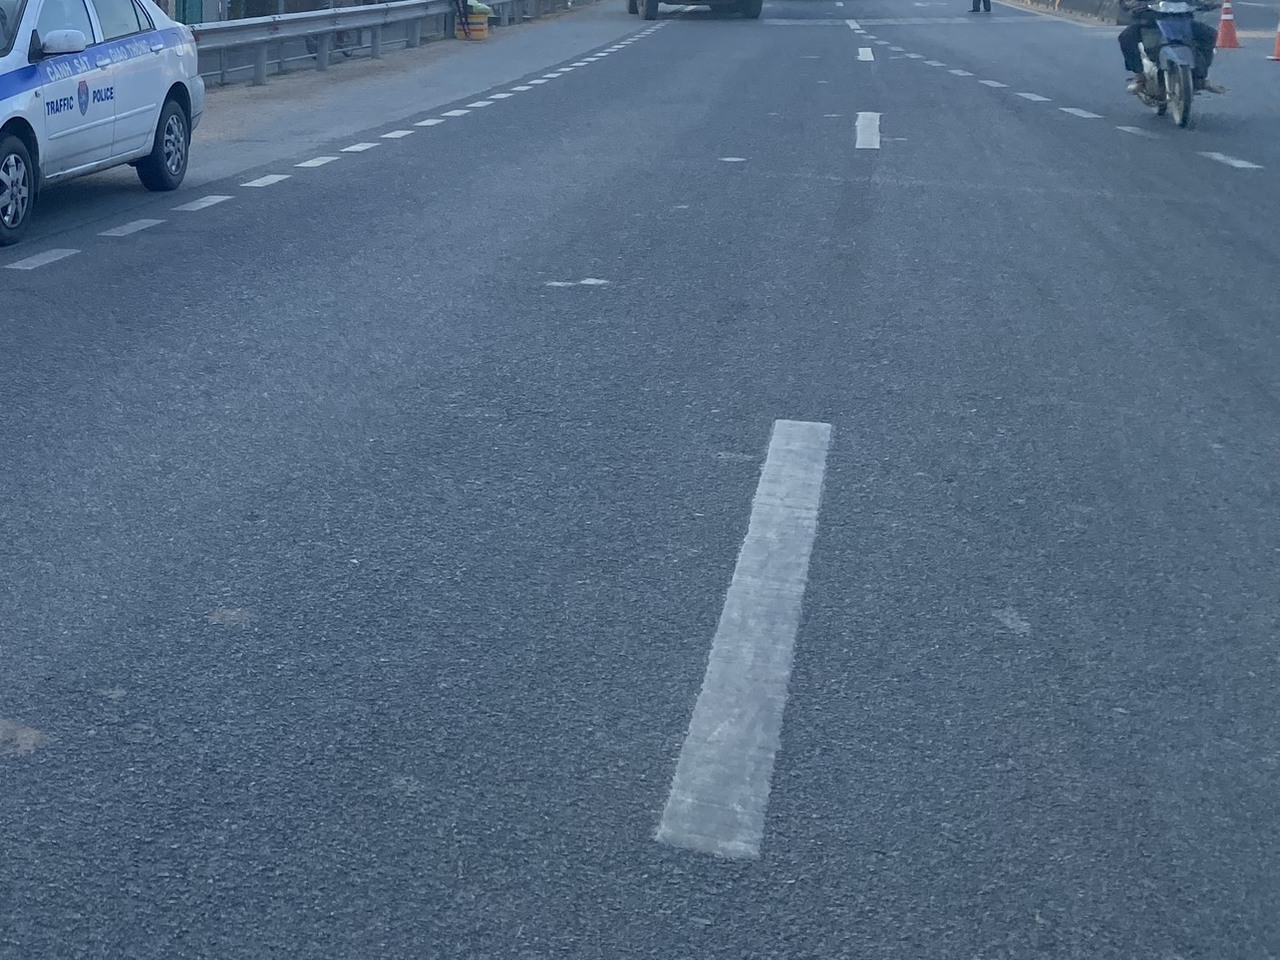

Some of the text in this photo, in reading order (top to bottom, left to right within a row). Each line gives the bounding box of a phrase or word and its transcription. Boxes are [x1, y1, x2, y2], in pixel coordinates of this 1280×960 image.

[73, 54, 91, 73] SÁT
[108, 45, 128, 64] GIAO
[46, 86, 114, 116] TRAFFIC POLICE
